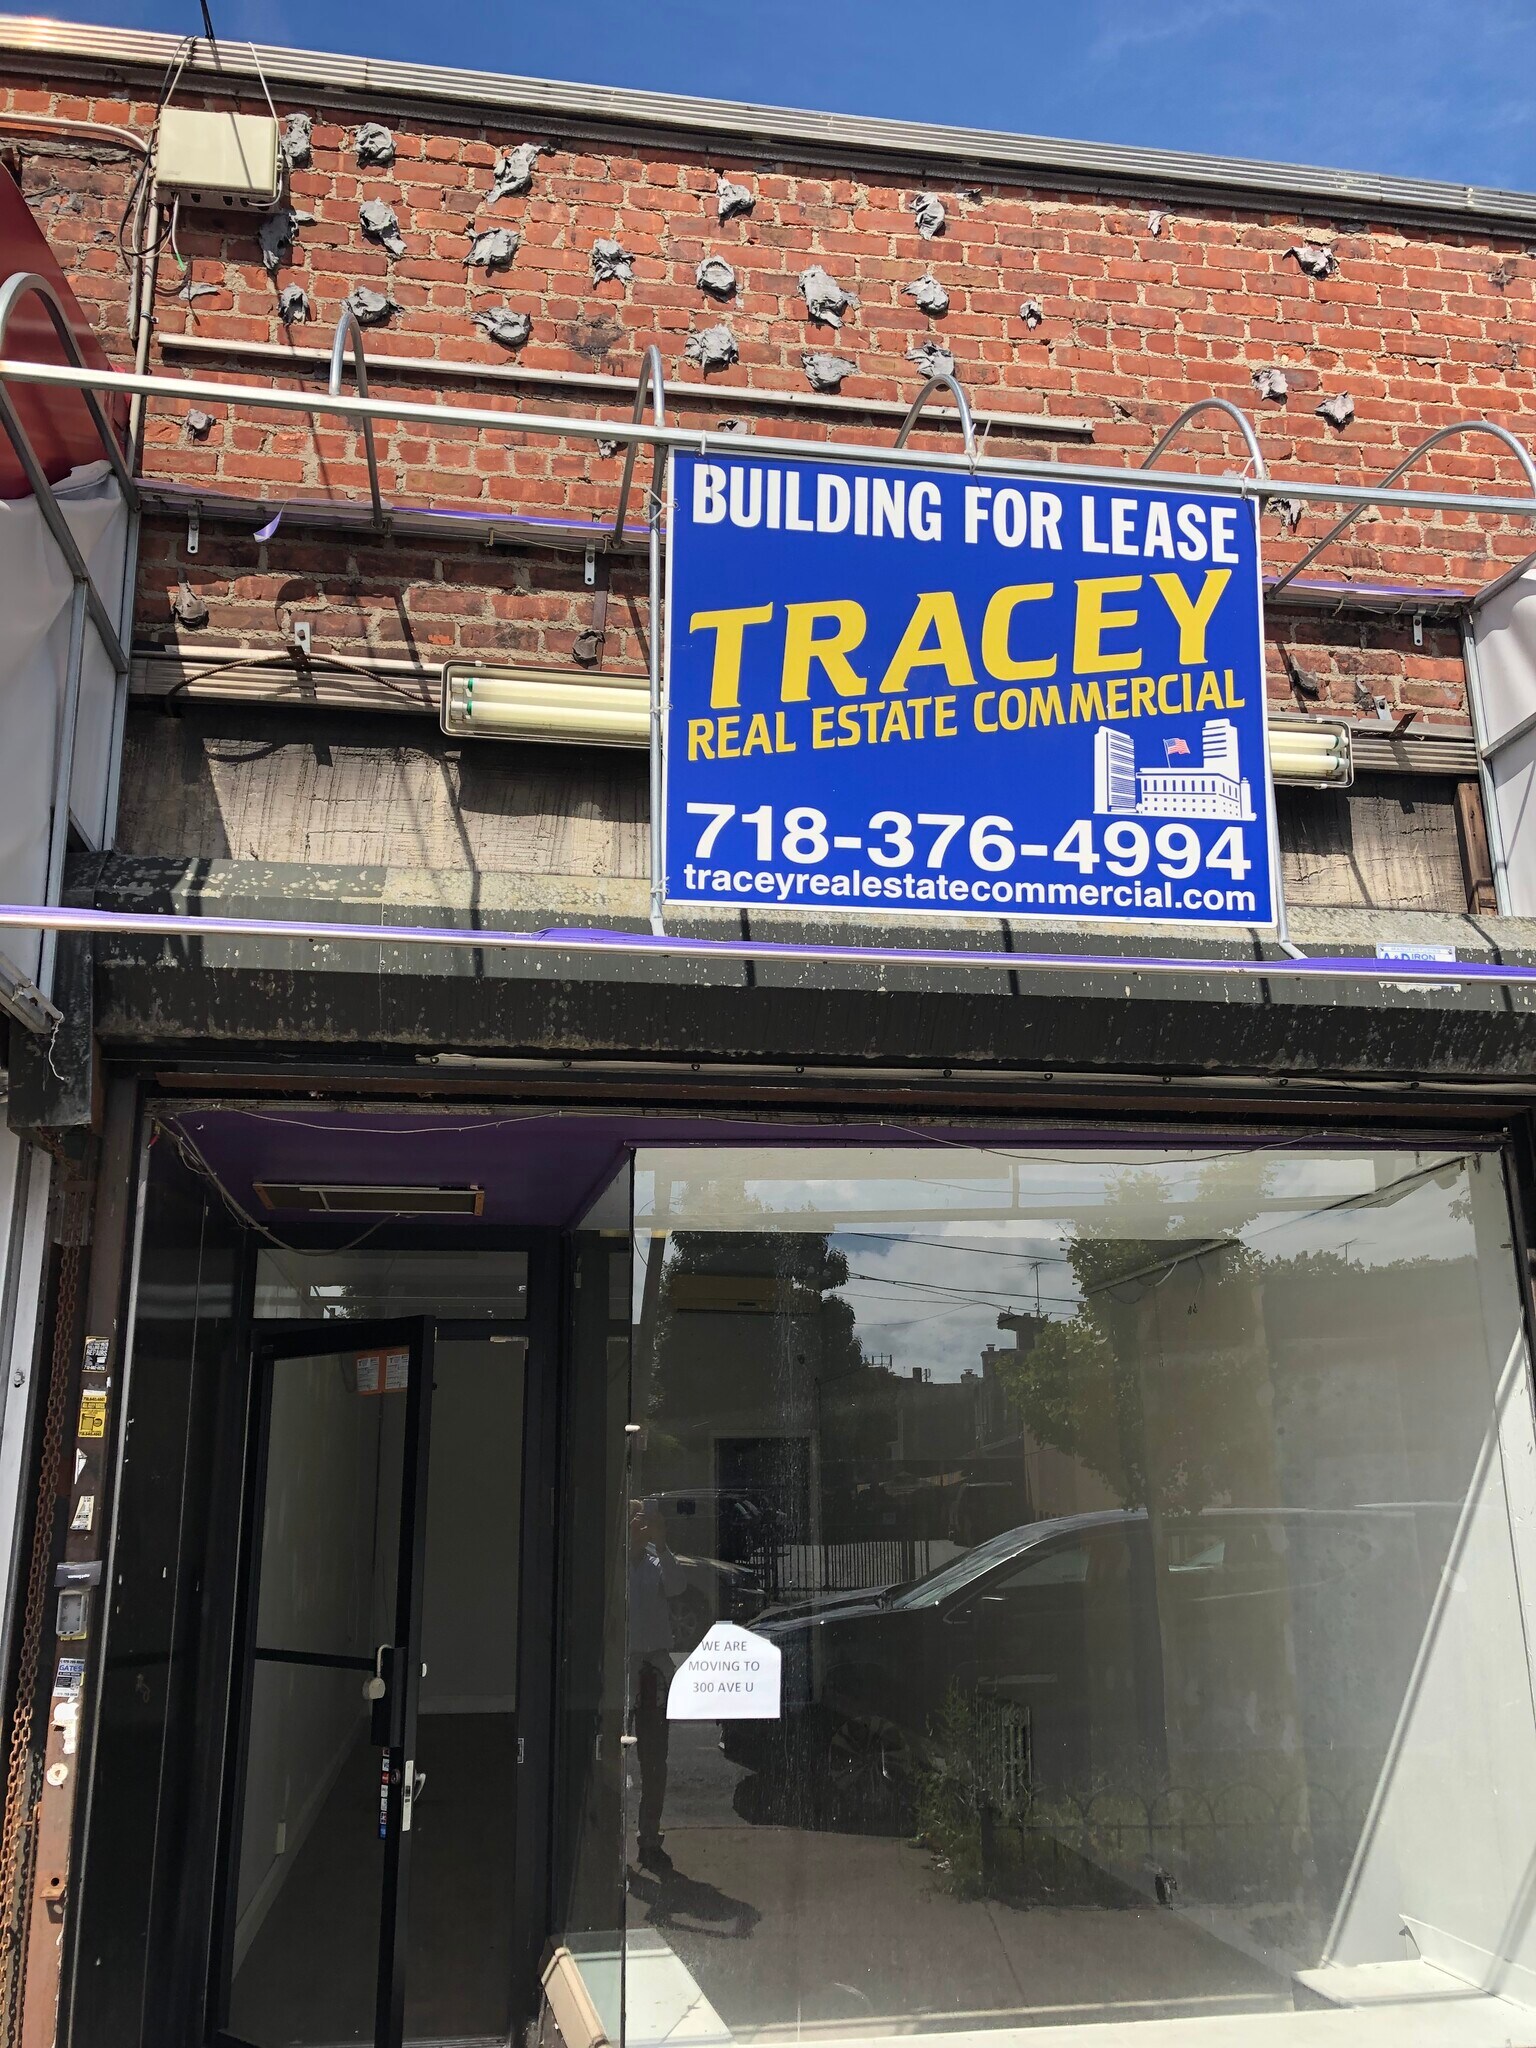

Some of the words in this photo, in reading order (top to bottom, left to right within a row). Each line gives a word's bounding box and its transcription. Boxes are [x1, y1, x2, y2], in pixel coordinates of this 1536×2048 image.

[692, 463, 943, 543] BUILDING
[964, 483, 1063, 551] FOR
[1081, 494, 1240, 564] LEASE
[689, 568, 1233, 709] TRACEY
[687, 710, 797, 762] REAL
[812, 693, 959, 750] ESTATE
[973, 668, 1246, 734] COMMERCIAL
[685, 802, 1253, 881] 718-376-4994
[683, 862, 1257, 912] traceyrealestatecommercial.com
[1411, 953, 1436, 961] IRON
[701, 1640, 721, 1652] WE
[723, 1640, 748, 1652] ARE
[59, 1664, 83, 1672] GATES
[688, 1660, 740, 1672] MOVING
[743, 1660, 760, 1672] TO
[692, 1682, 715, 1693] 300
[717, 1682, 742, 1693] AVE
[745, 1682, 754, 1693] U
